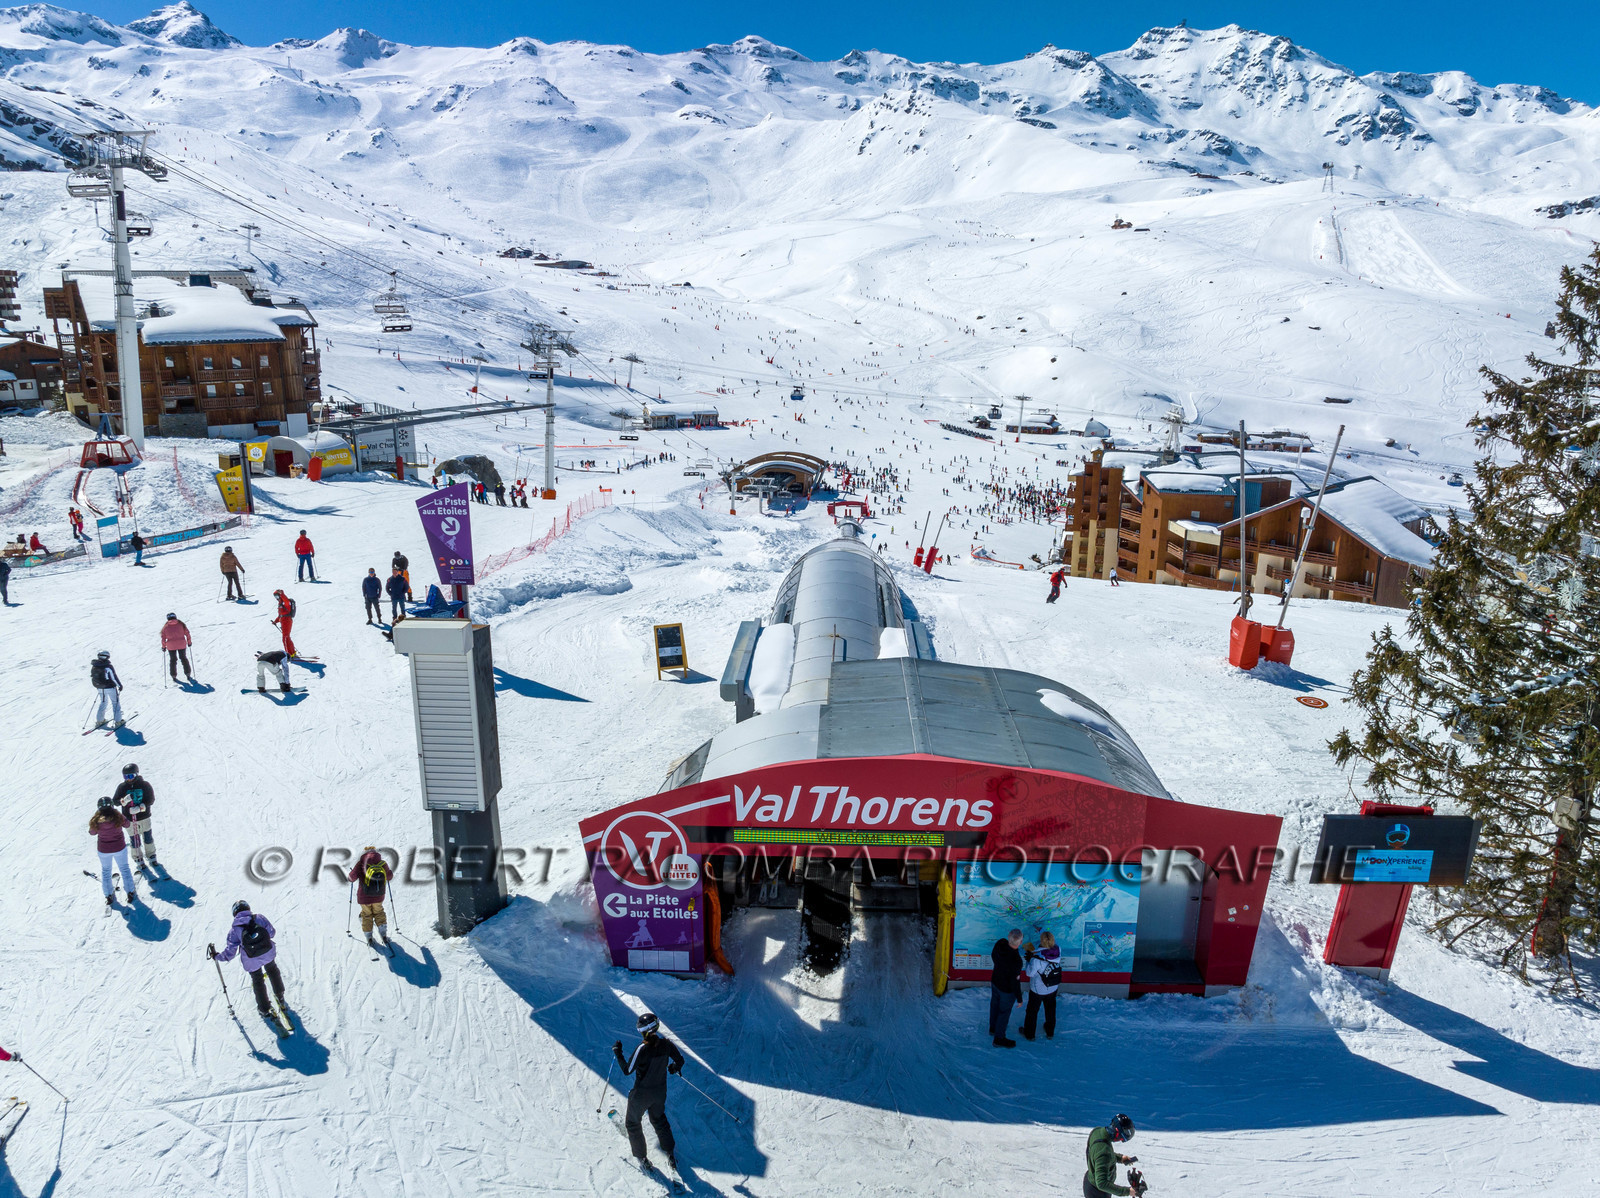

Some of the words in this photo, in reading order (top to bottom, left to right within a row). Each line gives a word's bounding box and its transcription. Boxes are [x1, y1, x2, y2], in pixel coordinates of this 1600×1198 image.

[445, 497, 467, 506] Piste
[437, 507, 468, 515] Etoiles
[733, 784, 802, 822] Val
[809, 785, 994, 827] Thorens
[817, 833, 883, 843] WELCOME
[889, 834, 906, 844] TO
[630, 895, 642, 905] La
[646, 894, 679, 905] Piste
[630, 910, 650, 918] aux
[653, 908, 699, 919] Etoiles
